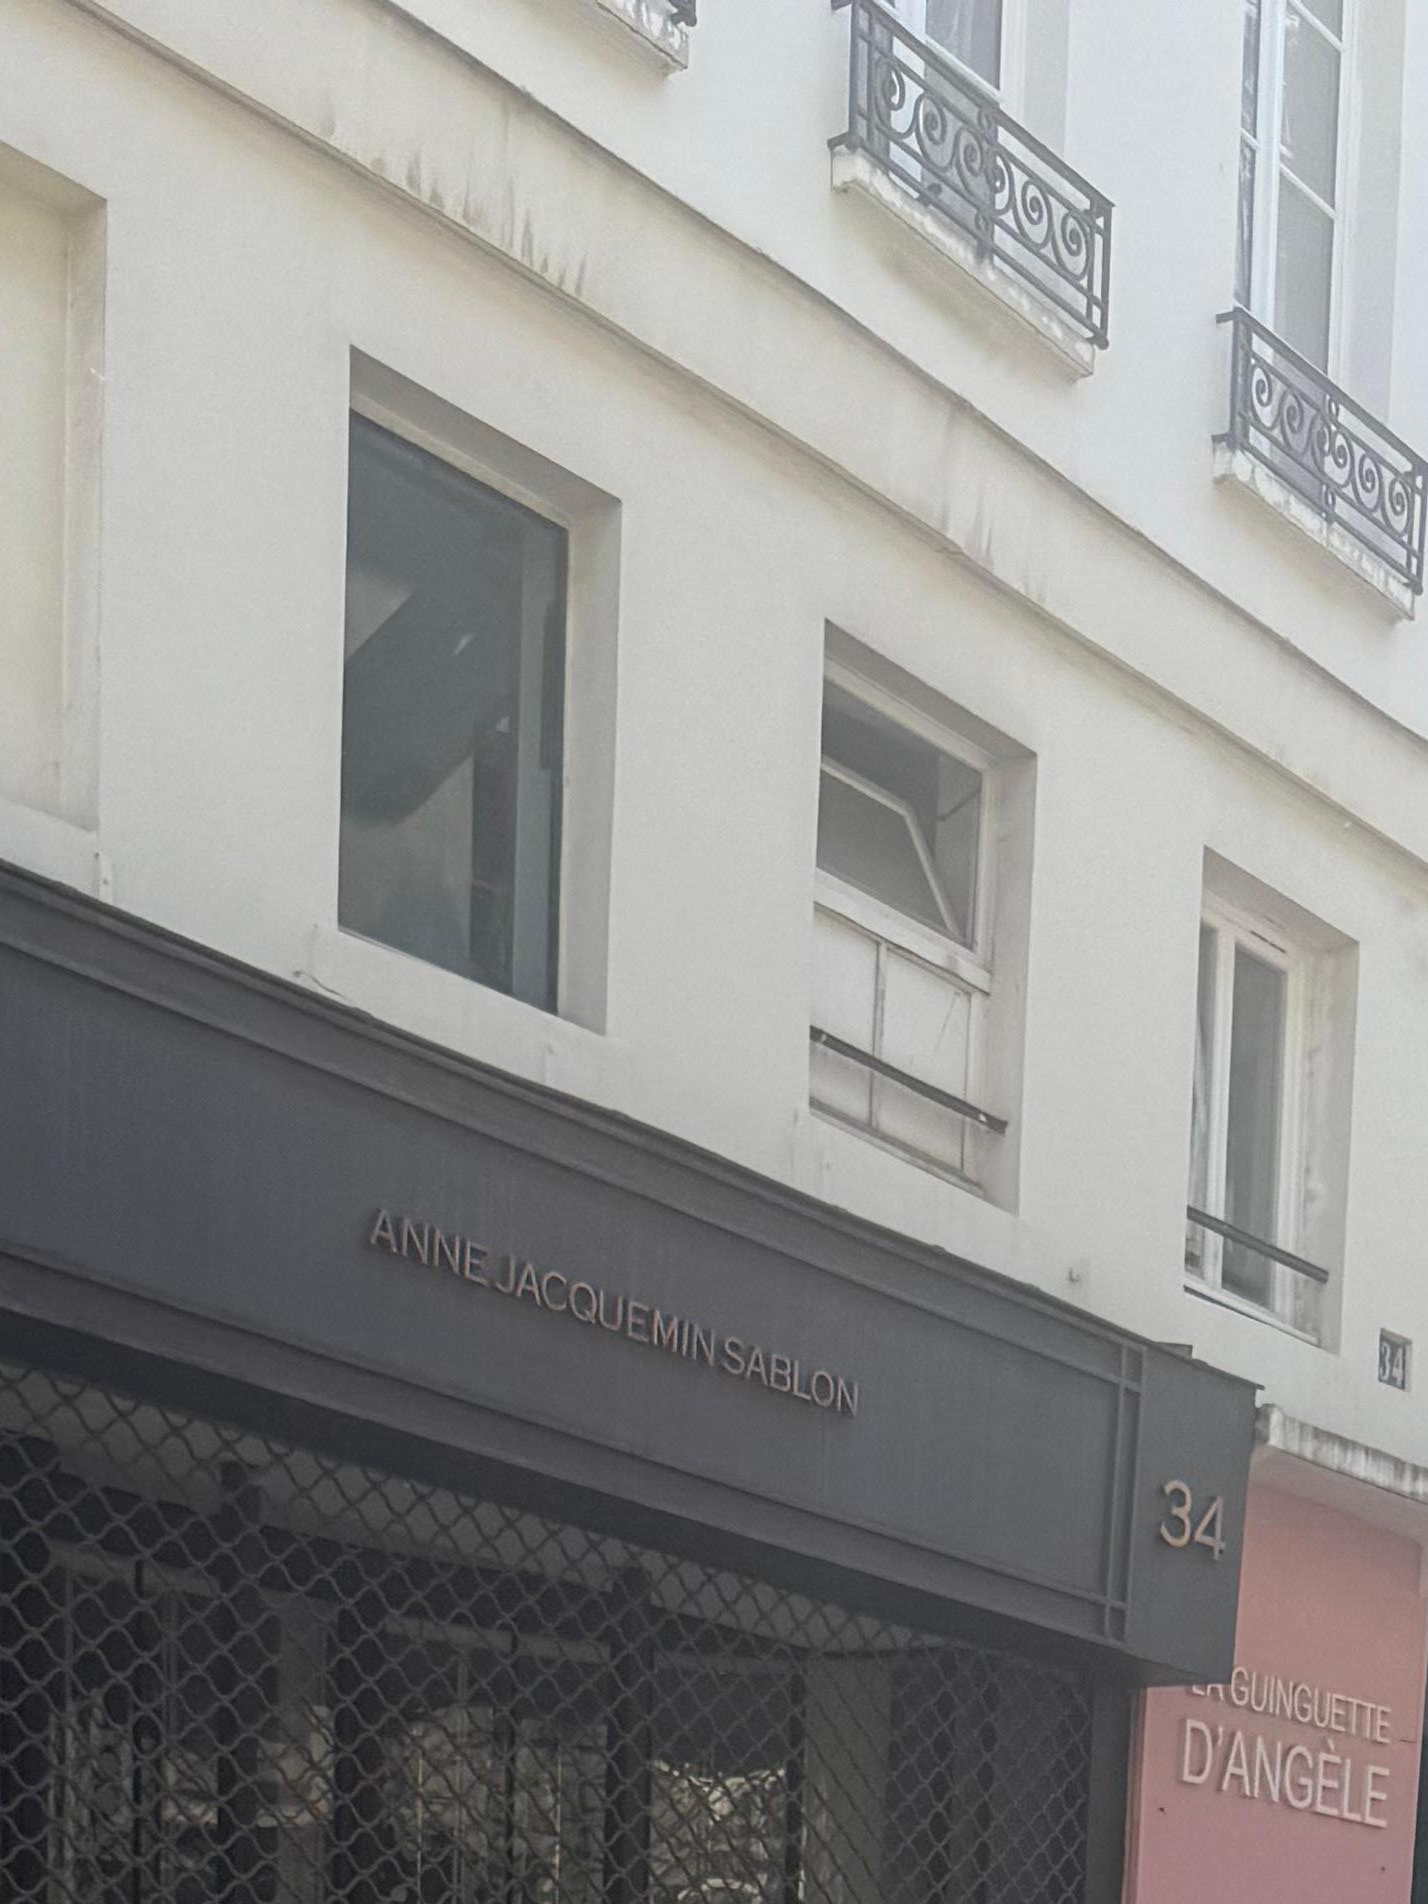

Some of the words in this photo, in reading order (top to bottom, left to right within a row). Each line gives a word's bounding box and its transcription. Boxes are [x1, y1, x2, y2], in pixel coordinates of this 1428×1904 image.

[370, 1208, 489, 1287] ANNE
[494, 1254, 717, 1367] JACQUEMIN
[722, 1335, 860, 1417] SABLON
[1158, 1479, 1226, 1561] 34
[1230, 1666, 1392, 1745] GUINGUETTE
[1180, 1719, 1392, 1829] D'ANGÈLE
